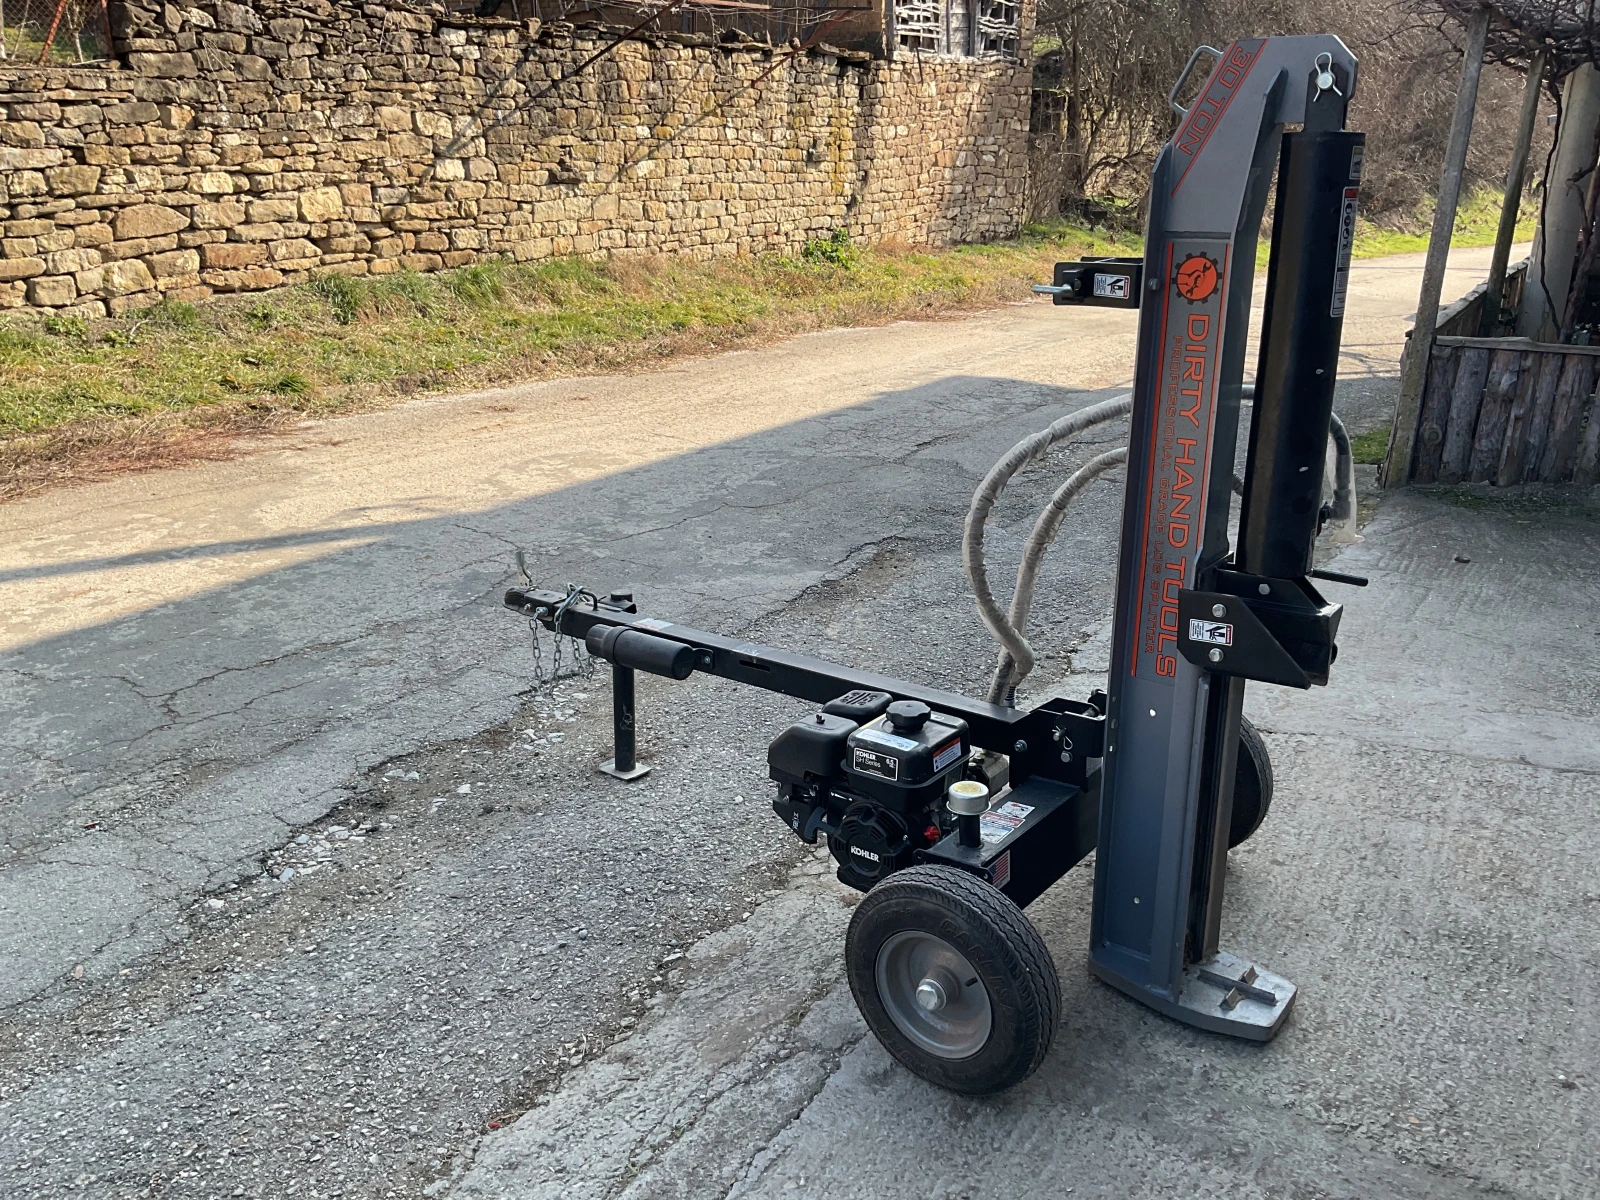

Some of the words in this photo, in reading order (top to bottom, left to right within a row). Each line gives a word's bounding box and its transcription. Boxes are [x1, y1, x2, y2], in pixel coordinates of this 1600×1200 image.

[1219, 46, 1252, 88] 30
[1178, 97, 1226, 155] TON
[1179, 313, 1210, 428] DIRTY
[1161, 335, 1183, 471] PROFESSIONAL
[1155, 478, 1169, 535] GRADE
[1167, 437, 1197, 548] HAND
[1151, 540, 1164, 574] LOG
[1144, 580, 1160, 654] SPLITTER
[1155, 556, 1187, 678] TOOLS
[856, 750, 877, 760] KOHLER
[865, 759, 881, 768] Series
[850, 845, 880, 862] KOHLER
